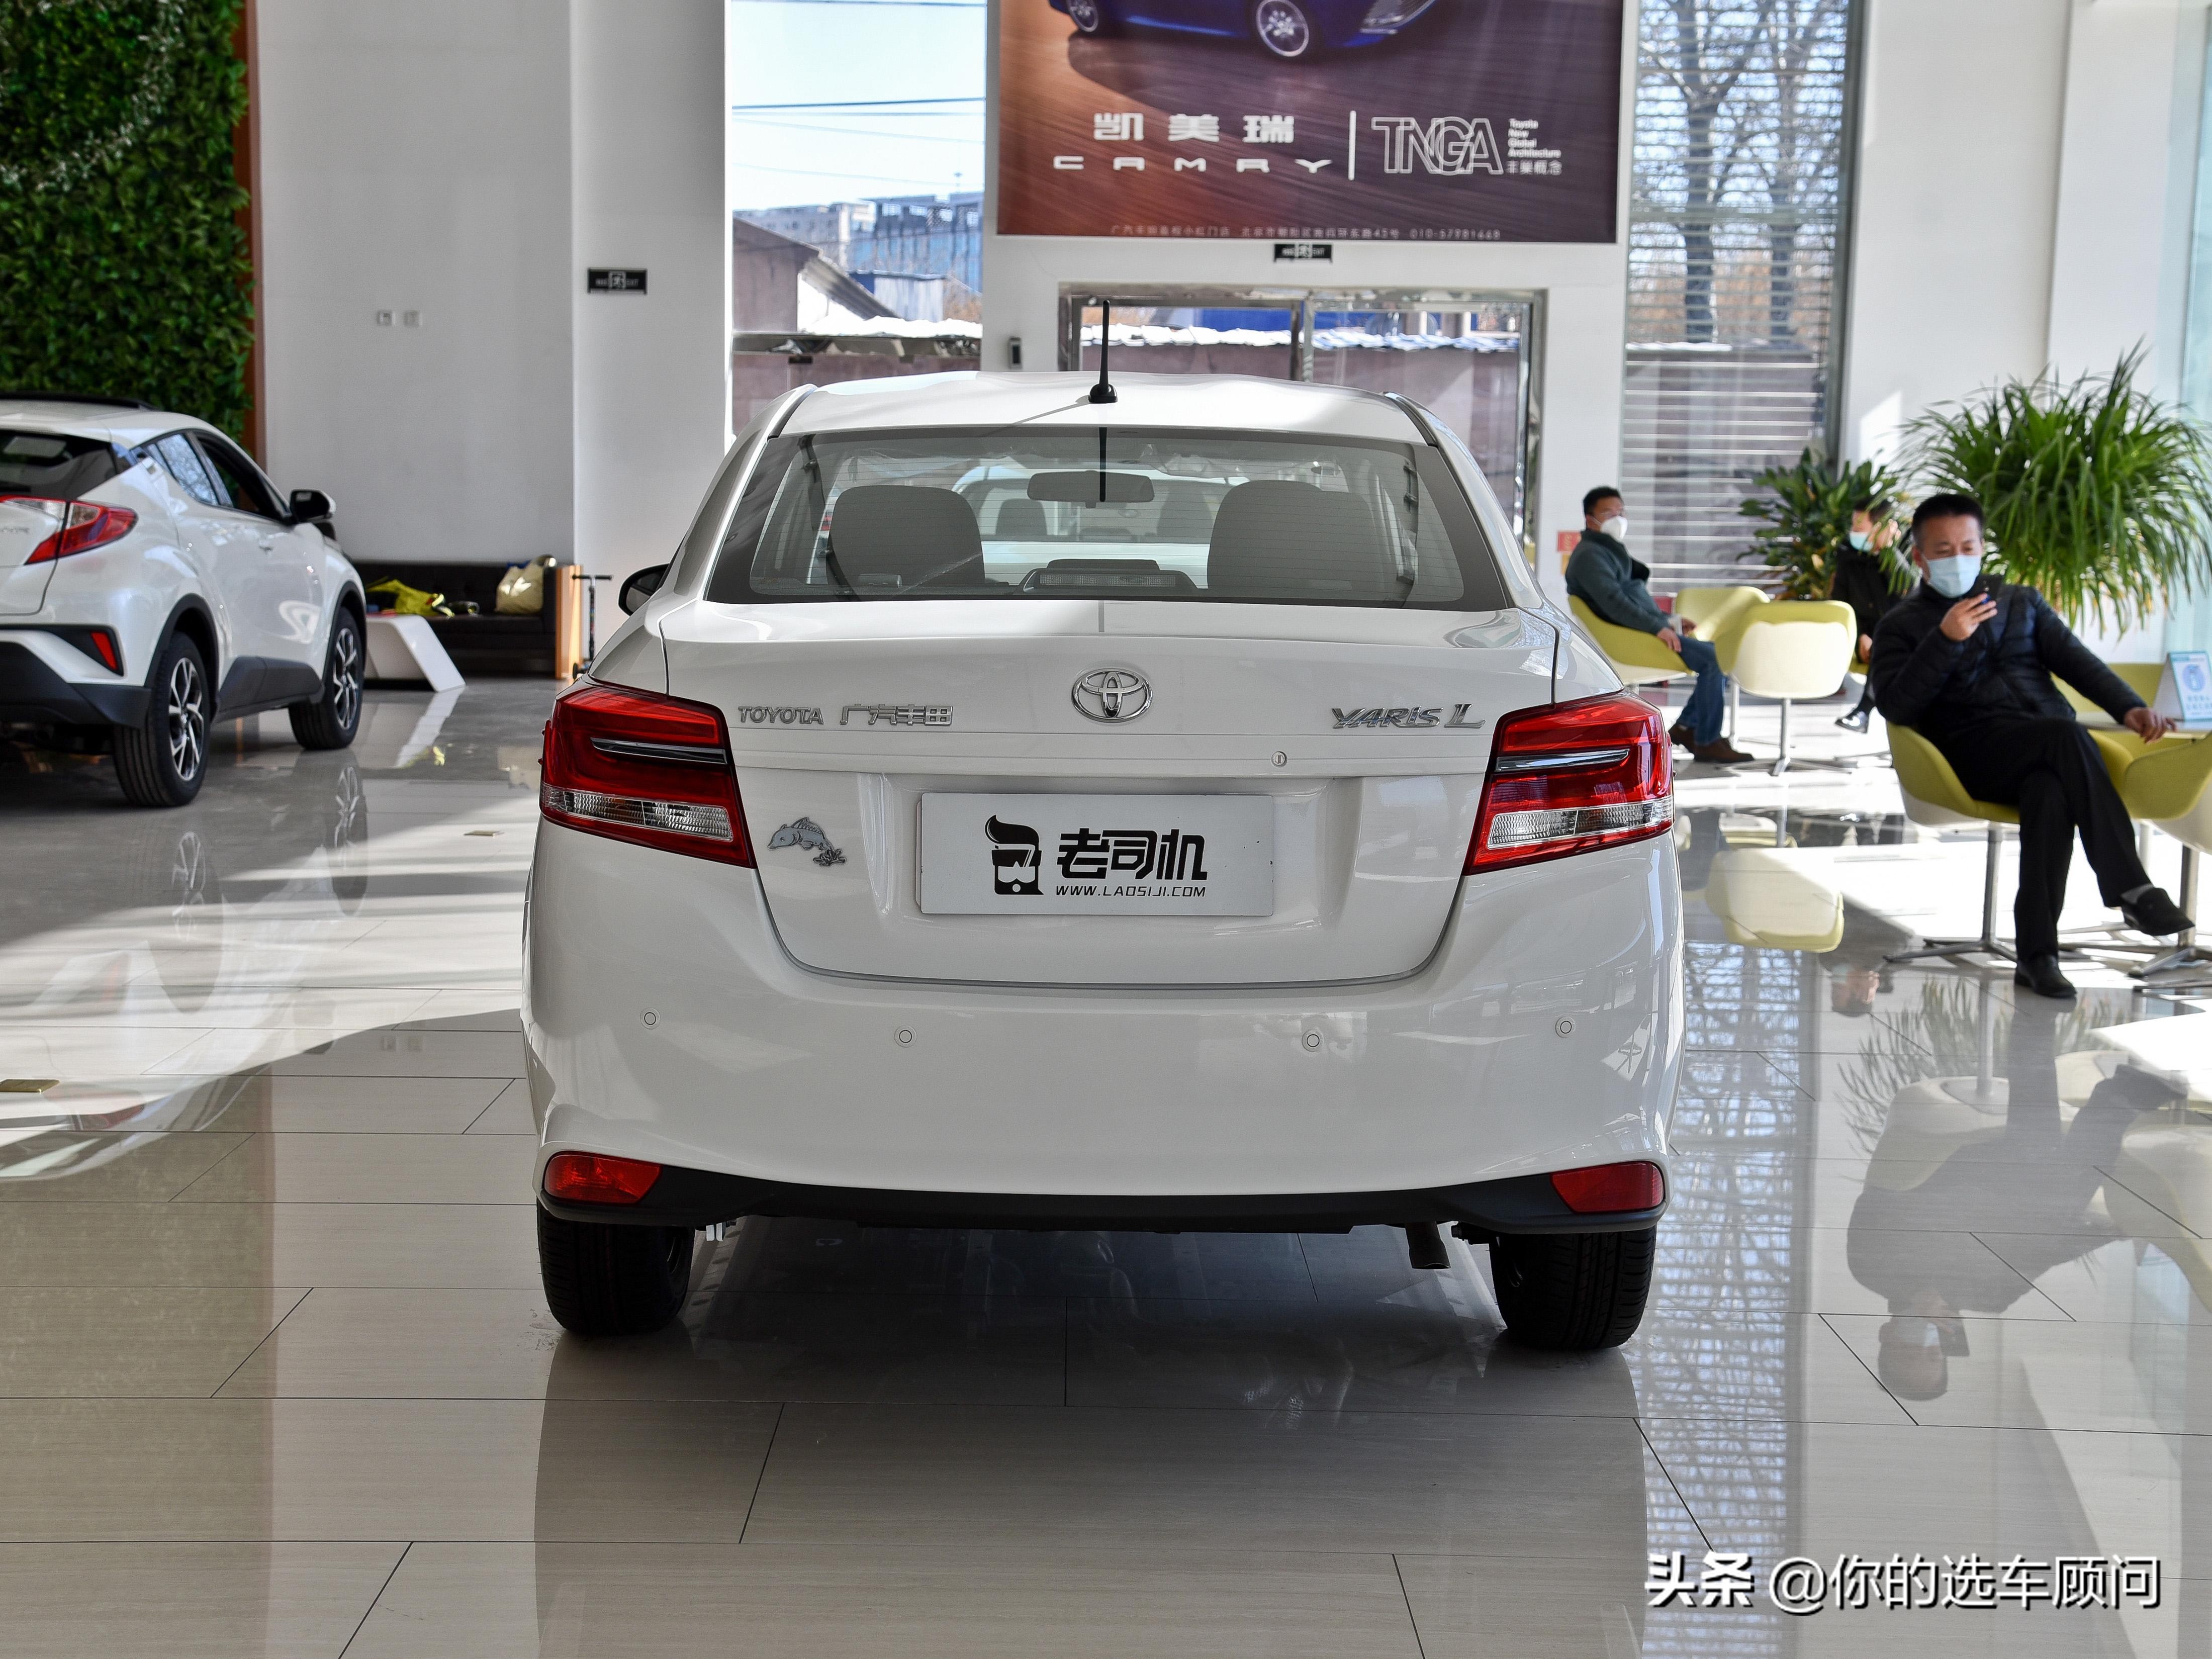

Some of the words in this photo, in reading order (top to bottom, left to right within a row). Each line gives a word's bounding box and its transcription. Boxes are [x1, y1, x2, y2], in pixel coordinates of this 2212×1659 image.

[1094, 112, 1295, 144] 凯美瑞
[1508, 128, 1529, 138] New
[1509, 118, 1539, 130] Toyota
[1371, 116, 1504, 176] TNGA
[1508, 138, 1537, 148] Global
[1508, 148, 1561, 158] Architecture
[1053, 155, 1333, 173] CAMRY
[738, 706, 823, 724] TOYOTA
[840, 704, 953, 726] 广汽丰田
[1444, 703, 1486, 728] L
[1057, 828, 1208, 880] 老司机
[1056, 885, 1206, 897] WWW.LAOSIJI.COM
